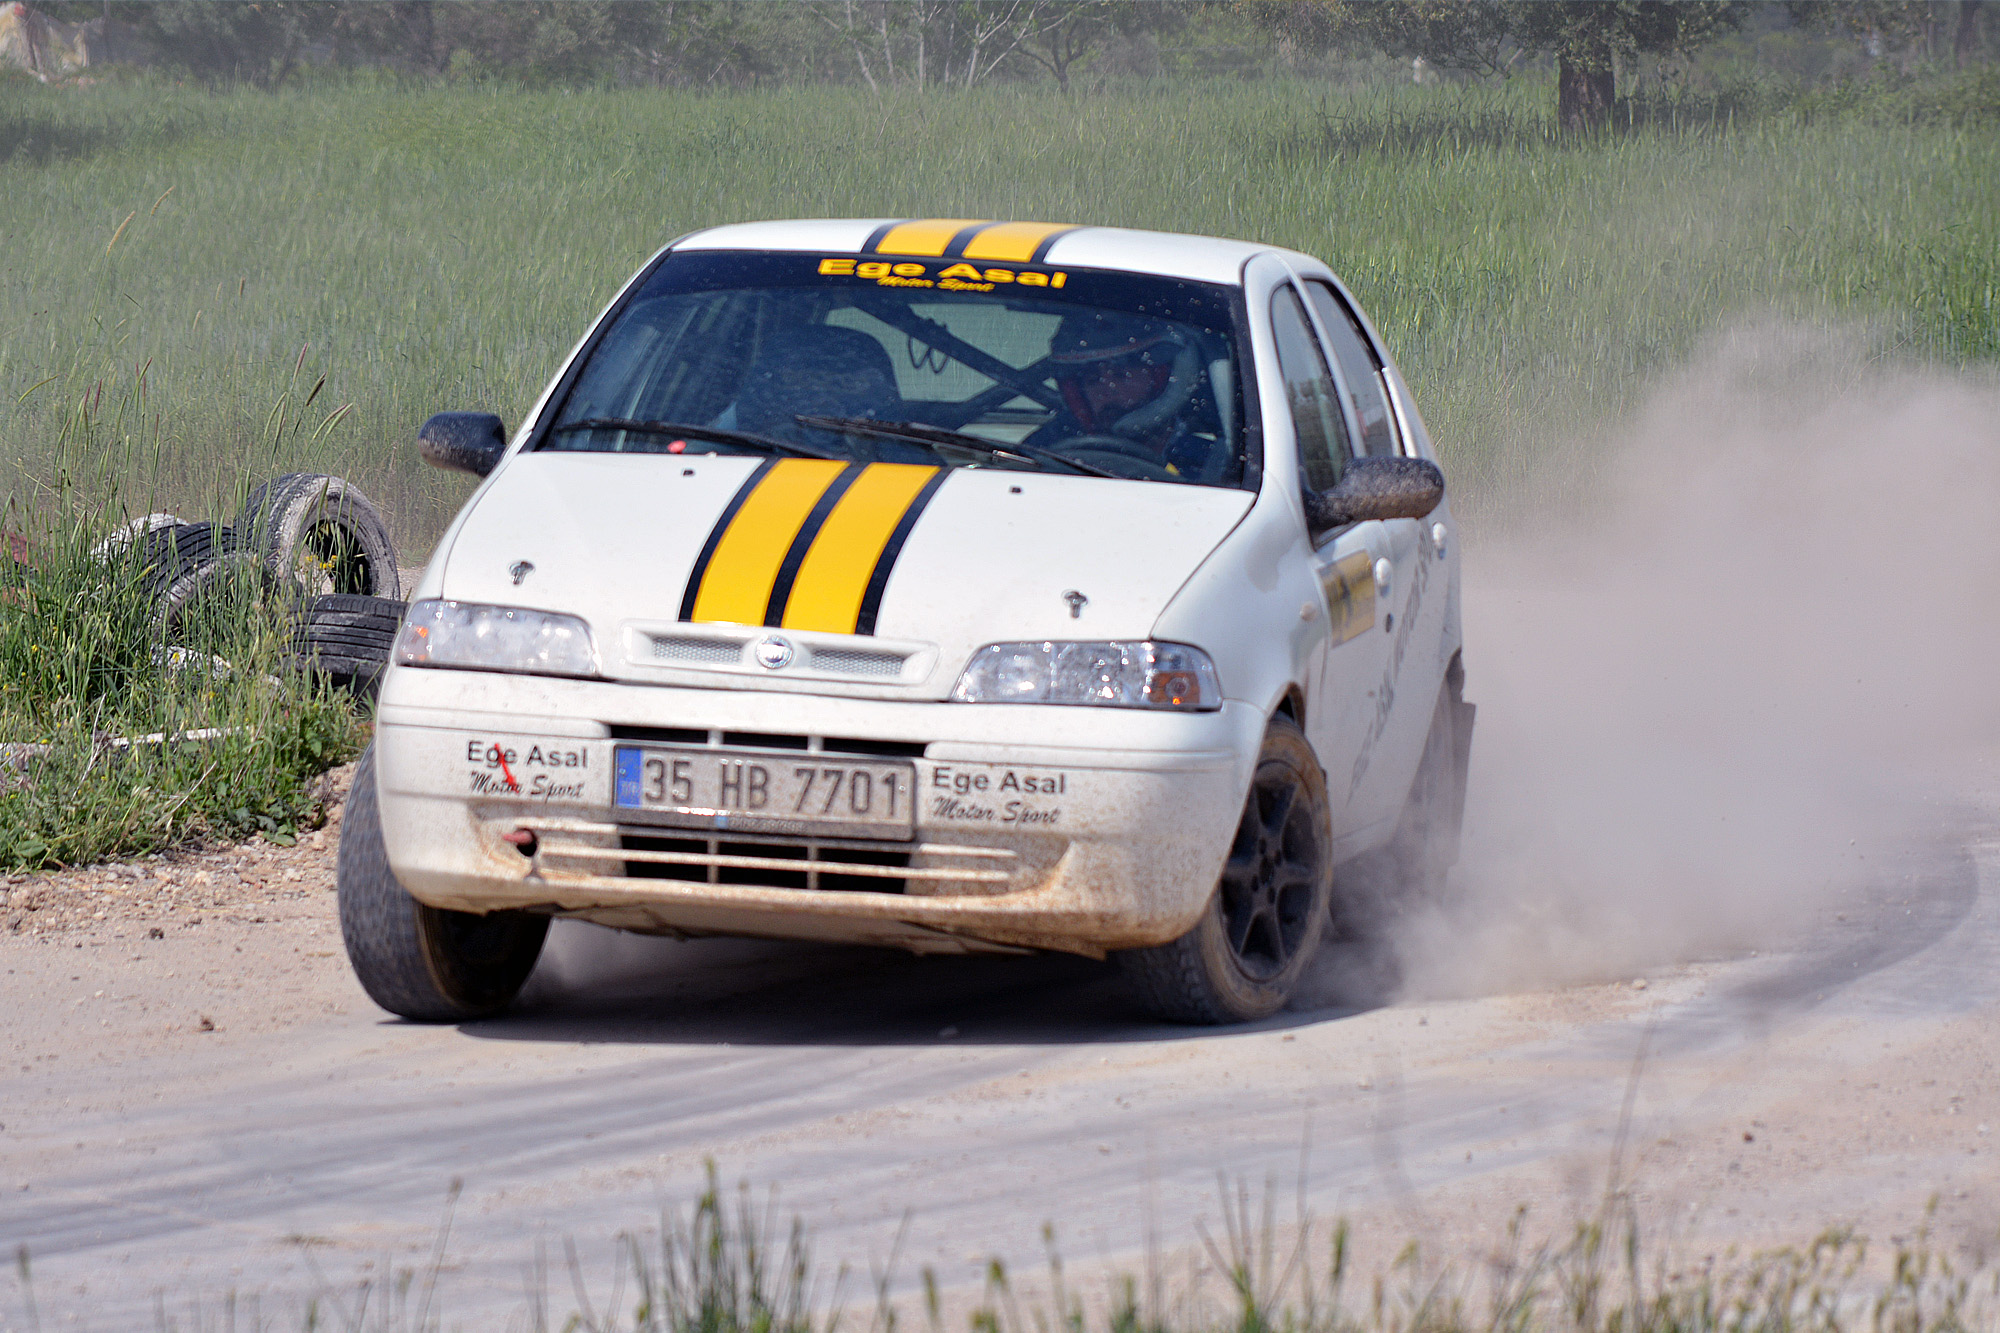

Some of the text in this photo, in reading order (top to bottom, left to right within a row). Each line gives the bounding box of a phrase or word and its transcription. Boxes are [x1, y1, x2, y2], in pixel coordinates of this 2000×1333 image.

[817, 258, 1068, 289] Ege Asal
[468, 741, 588, 769] Ege Asal
[470, 771, 585, 804] Motor Sport
[644, 758, 897, 816] 35 HB 7701
[932, 766, 1066, 795] Ege Asal
[933, 795, 1061, 828] Motor Sport
